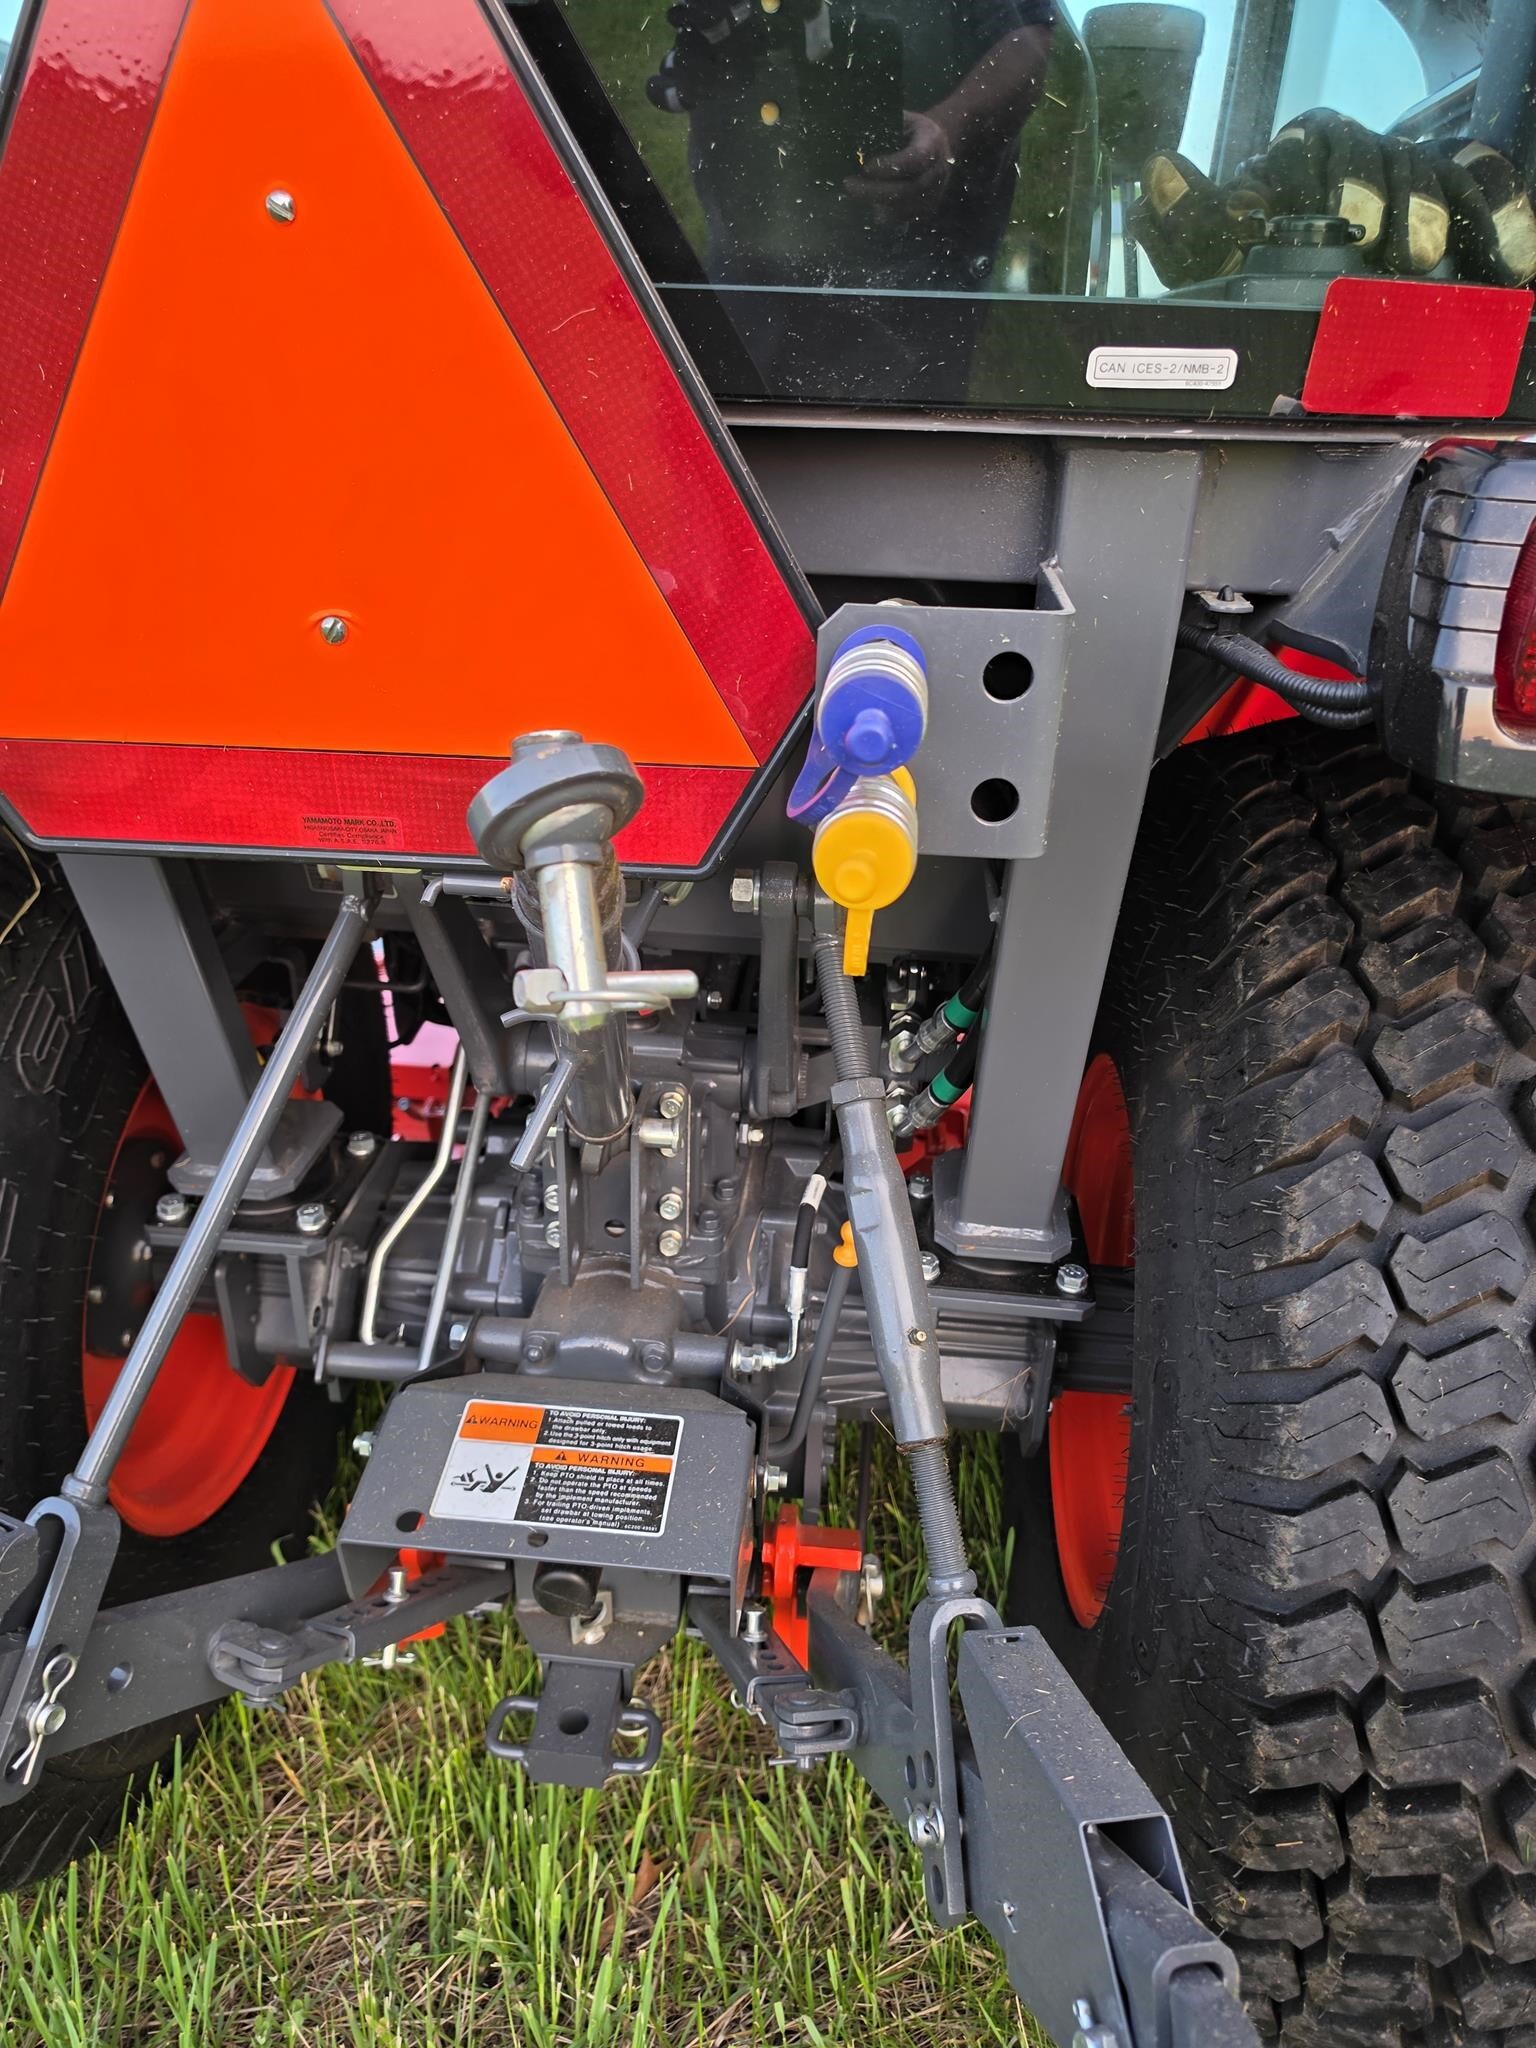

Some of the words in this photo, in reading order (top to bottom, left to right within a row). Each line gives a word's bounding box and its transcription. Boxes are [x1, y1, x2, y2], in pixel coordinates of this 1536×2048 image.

[1100, 362, 1126, 374] CAN
[1132, 363, 1224, 375] ICES-2/NMB-2
[303, 816, 342, 825] YAMAMOTO
[343, 818, 364, 826] MARK
[479, 1416, 538, 1429] WARNING
[581, 1412, 618, 1421] PERSONAL
[591, 1427, 607, 1435] only.
[548, 1437, 579, 1446] designed
[590, 1441, 614, 1449] 3-point
[614, 1442, 631, 1450] hitch
[578, 1453, 646, 1468] WARNING
[568, 1465, 607, 1474] PERSONAL
[540, 1470, 558, 1478] Keep
[559, 1471, 575, 1479] PTO
[644, 1479, 665, 1487] times.
[602, 1482, 618, 1490] PTO
[535, 1491, 544, 1499] by
[557, 1493, 593, 1502] implement
[594, 1497, 641, 1506] manufacturer.
[588, 1489, 609, 1497] speed
[610, 1491, 658, 1500] recommended
[532, 1498, 545, 1506] For
[546, 1500, 570, 1509] trailing
[538, 1514, 555, 1522] (see
[555, 1515, 590, 1525] operator's
[592, 1519, 620, 1528] manual)
[553, 1508, 581, 1516] drawbar
[591, 1511, 614, 1520] towing
[615, 1514, 645, 1522] position.
